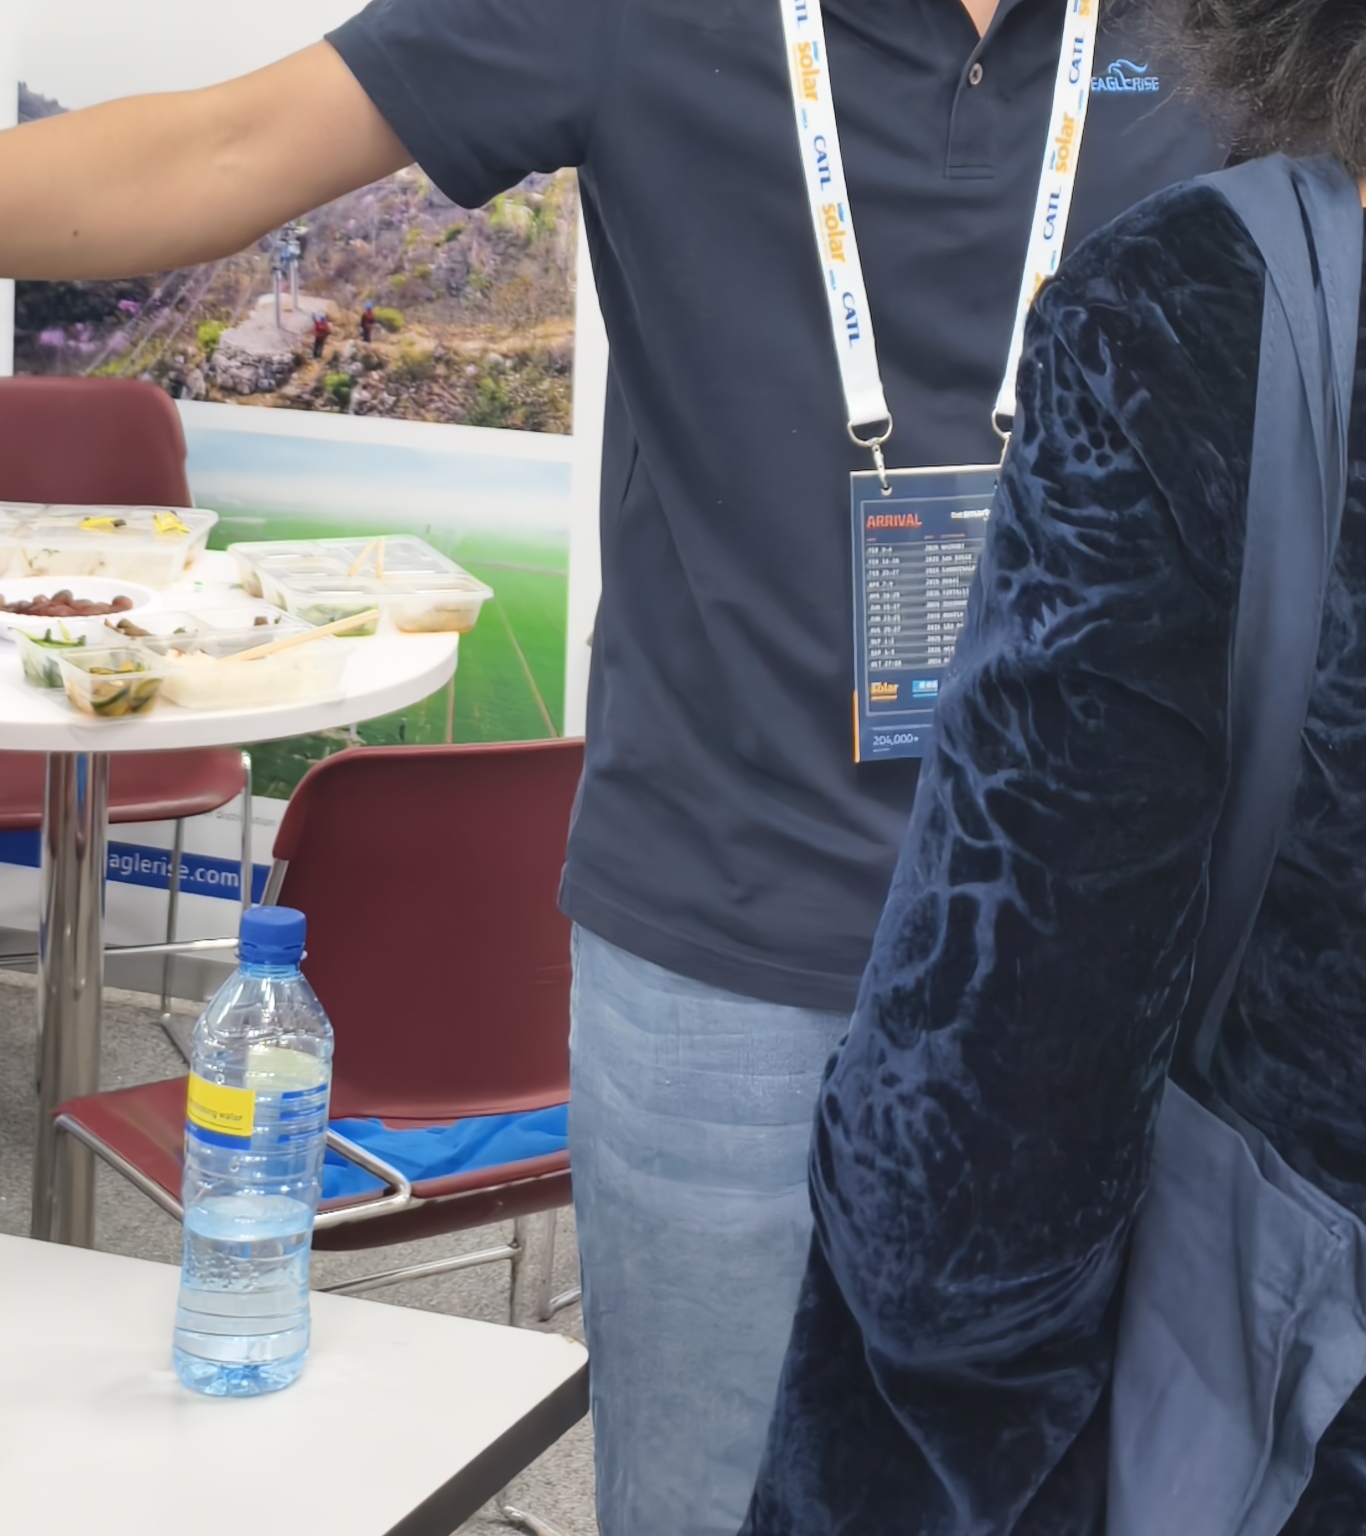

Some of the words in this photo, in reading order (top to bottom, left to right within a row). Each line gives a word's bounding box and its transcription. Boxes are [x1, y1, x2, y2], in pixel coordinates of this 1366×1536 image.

[796, 40, 821, 103] solar
[1068, 35, 1086, 84] CATL
[1090, 74, 1160, 92] EAGLERISE
[812, 134, 835, 192] CATL
[1053, 111, 1077, 175] solar
[821, 200, 847, 264] solar
[1042, 185, 1062, 241] CATL
[841, 290, 861, 348] CATL
[866, 513, 922, 528] ARRIVAL
[109, 852, 240, 888] aglerise.com
